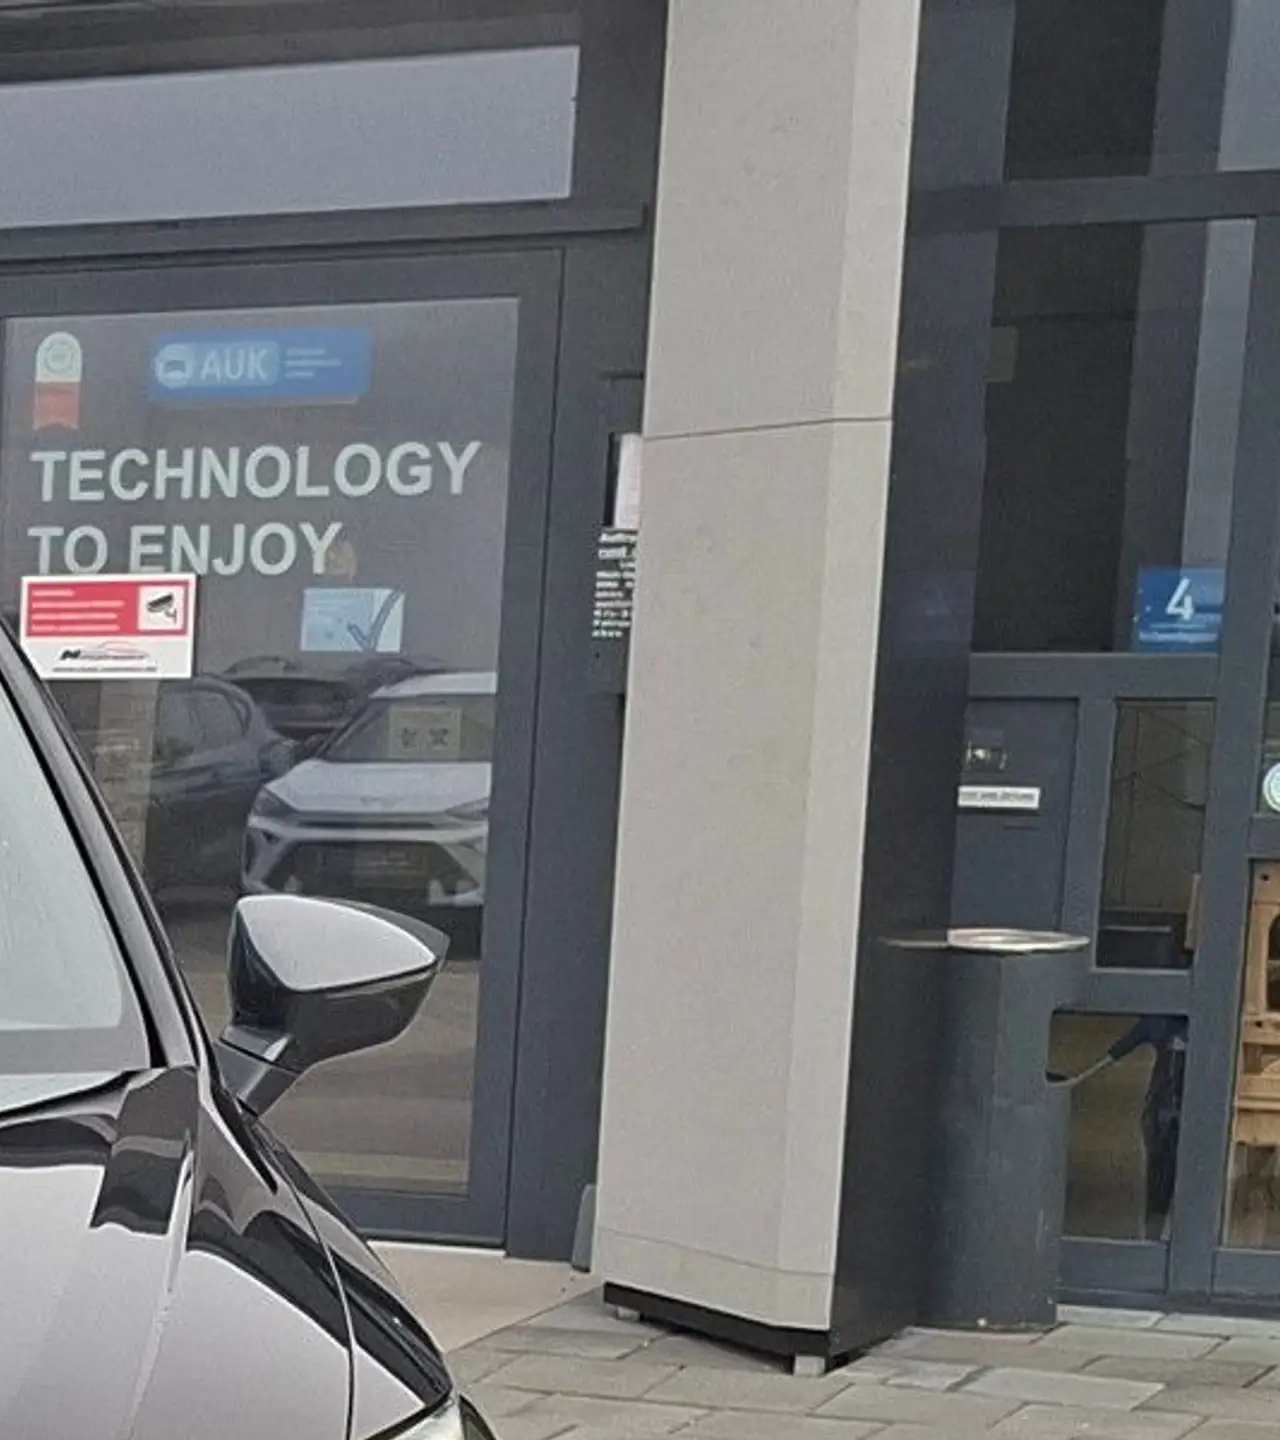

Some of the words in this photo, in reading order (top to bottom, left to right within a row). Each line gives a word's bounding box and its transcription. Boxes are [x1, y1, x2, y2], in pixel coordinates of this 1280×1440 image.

[200, 347, 267, 382] AUK
[31, 440, 482, 503] TECHNOLOGY
[28, 527, 108, 576] TO
[130, 522, 343, 576] ENJOY
[1165, 577, 1195, 621] 4
